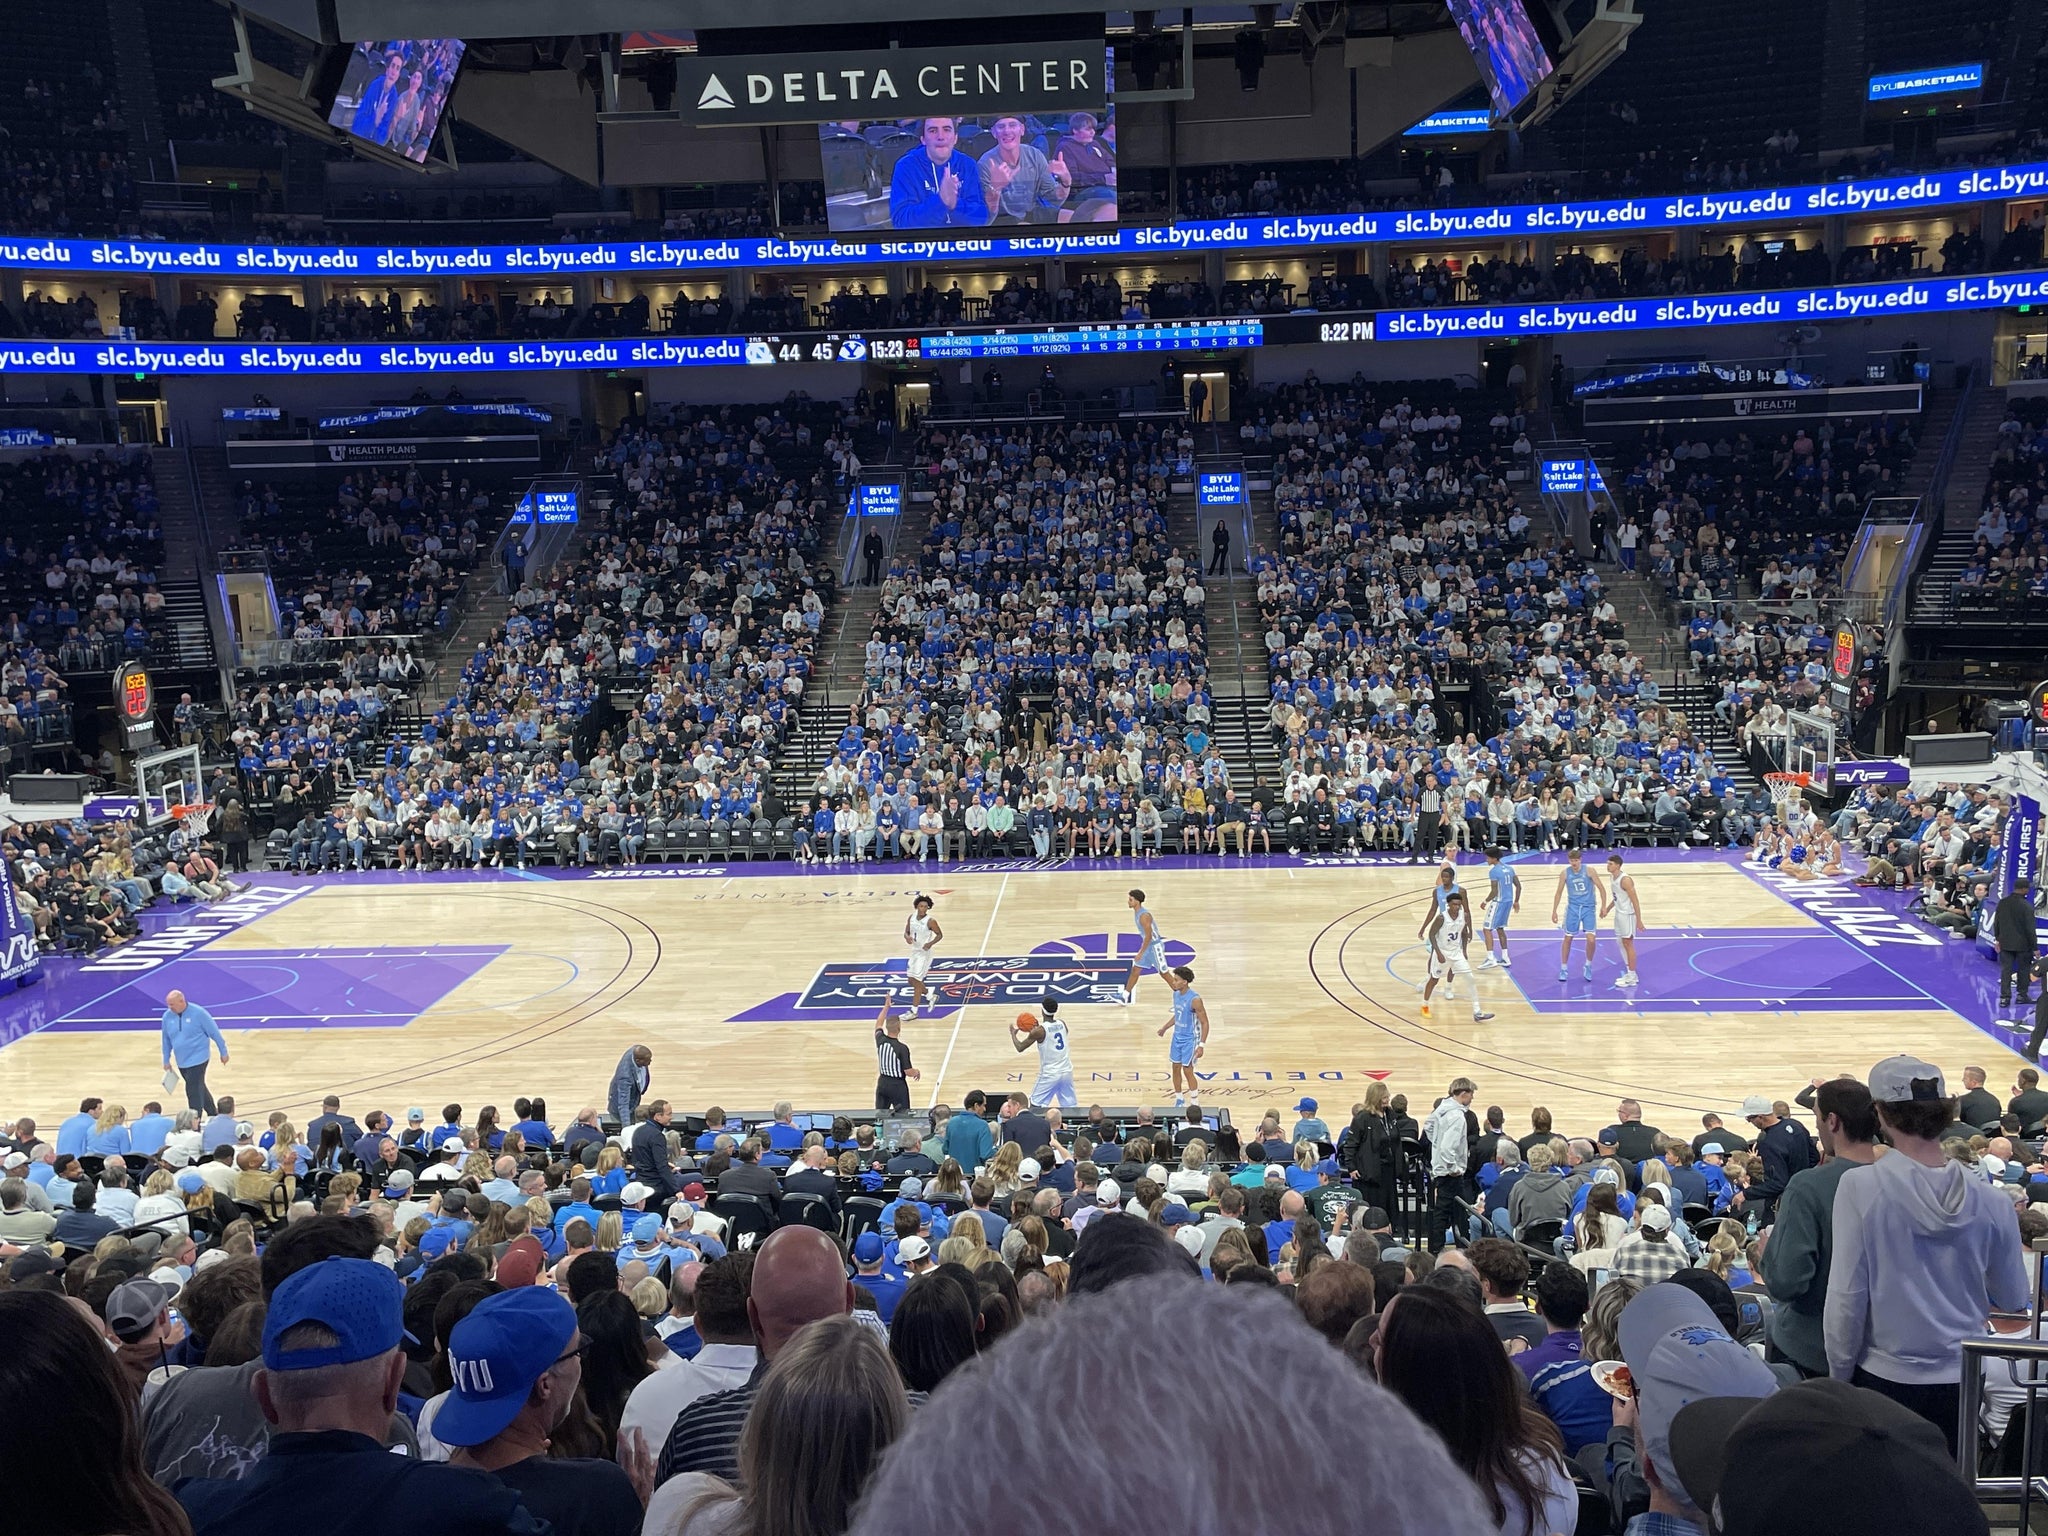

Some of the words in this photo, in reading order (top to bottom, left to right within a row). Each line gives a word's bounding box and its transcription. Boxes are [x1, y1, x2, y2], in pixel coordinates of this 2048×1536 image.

[747, 71, 898, 103] DELTA
[917, 59, 1089, 97] CENTER
[92, 244, 220, 269] slc.byu.edu
[237, 248, 357, 271] slc.byu.edu
[377, 249, 491, 272] slc.byu.edu
[506, 246, 616, 270] slc.byu.edu
[631, 242, 739, 265] slc.byu.edu
[757, 239, 866, 262] slc.byu.edu
[1136, 222, 1247, 247] slc.byu.edu
[1263, 216, 1376, 241] slc.byu.edu
[1396, 210, 1511, 236] slc.byu.edu
[1527, 202, 1645, 229] slc.byu.edu
[1666, 192, 1790, 220] slc.byu.edu
[1808, 178, 1940, 208] slc.byu.edu
[1390, 310, 1504, 335] slc.byu.edu
[1519, 304, 1637, 329] slc.byu.edu
[1657, 296, 1780, 322] slc.byu.edu
[1798, 285, 1928, 314] slc.byu.edu
[1033, 335, 1048, 343] 9/11
[1117, 332, 1126, 340] 23
[1248, 326, 1255, 334] 12
[1321, 322, 1349, 342] 8:22
[1353, 322, 1373, 340] PM
[812, 343, 832, 360] 45
[870, 340, 903, 358] 15:23
[907, 339, 918, 348] 22
[983, 347, 999, 355] 2/15
[1117, 342, 1126, 350] 29
[1191, 339, 1199, 347] 10
[1228, 337, 1238, 345] 28
[97, 347, 224, 370] slc.byu.edu
[241, 348, 361, 371] slc.byu.edu
[381, 347, 493, 370] slc.byu.edu
[509, 344, 617, 367] slc.byu.edu
[632, 340, 740, 364] slc.byu.edu
[779, 344, 800, 361] 44
[906, 349, 919, 357] 2ND
[1754, 400, 1796, 409] HEALTH
[349, 446, 384, 455] HEALTH
[387, 445, 416, 454] PLANS
[1552, 463, 1575, 471] BYU
[1544, 473, 1561, 481] Salt
[1562, 472, 1582, 480] Lake
[1220, 485, 1240, 493] Lake
[1548, 482, 1578, 490] Center
[880, 496, 899, 504] Lake
[1834, 646, 1851, 675] 22
[126, 688, 146, 715] 22
[2022, 817, 2032, 850] FIRST
[1998, 850, 2007, 899] AMERICA
[2004, 815, 2015, 847] FIRST
[588, 868, 727, 878] SEATGEEK
[1504, 875, 1511, 885] 11
[1574, 882, 1586, 892] 13
[2, 882, 17, 930] AMERICA
[79, 925, 233, 972] UTAH
[195, 885, 314, 923] JAZZ
[1803, 902, 1944, 946] JAZZ
[1, 964, 24, 981] AMERICA
[24, 957, 39, 970] FIRST
[849, 972, 1100, 985] MOWERS
[1006, 984, 1128, 998] BAD
[1177, 1010, 1182, 1021] 7
[1055, 1033, 1065, 1051] 3
[1194, 1071, 1343, 1081] DELTA
